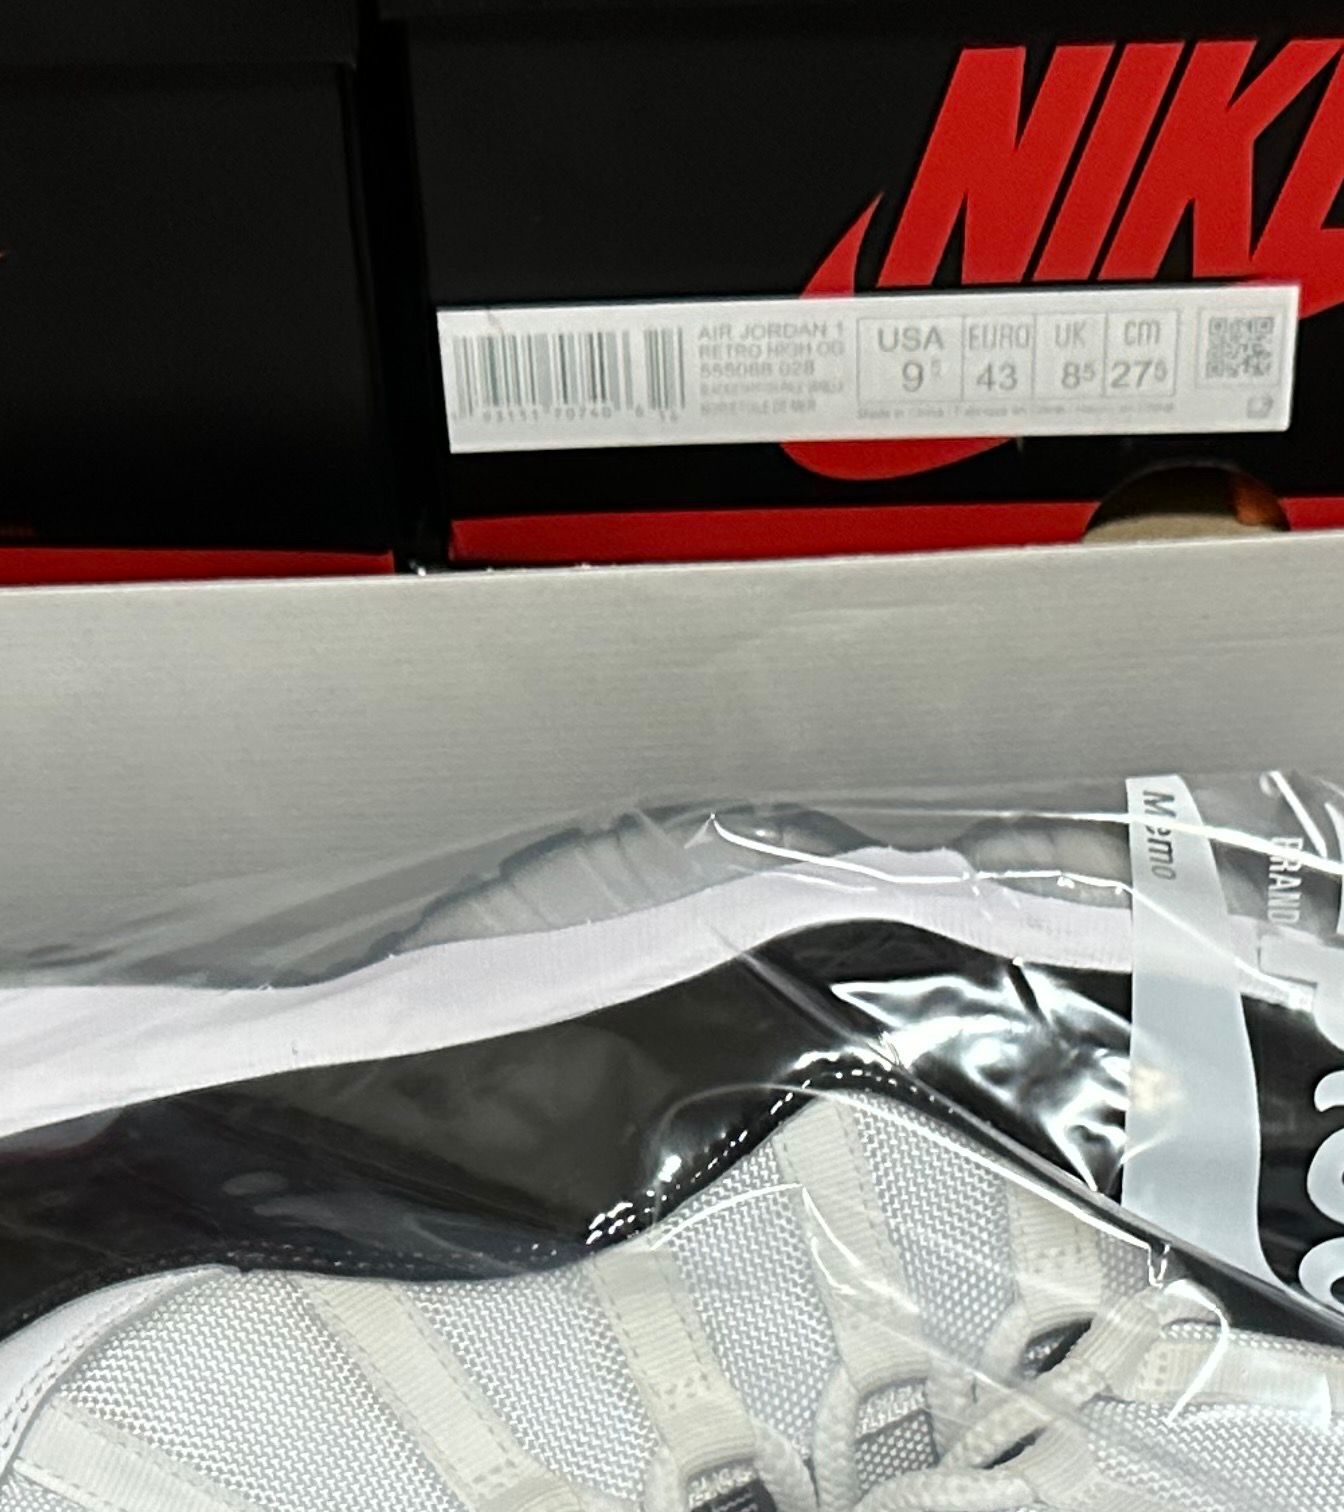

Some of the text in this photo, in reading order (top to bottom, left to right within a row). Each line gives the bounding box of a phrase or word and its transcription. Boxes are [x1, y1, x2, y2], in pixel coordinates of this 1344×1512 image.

[698, 323, 732, 341] AIR
[740, 320, 827, 340] JORDAN
[877, 326, 945, 354] USA
[968, 323, 1030, 351] EURO
[1056, 320, 1086, 349] UK
[976, 362, 1018, 392] 43
